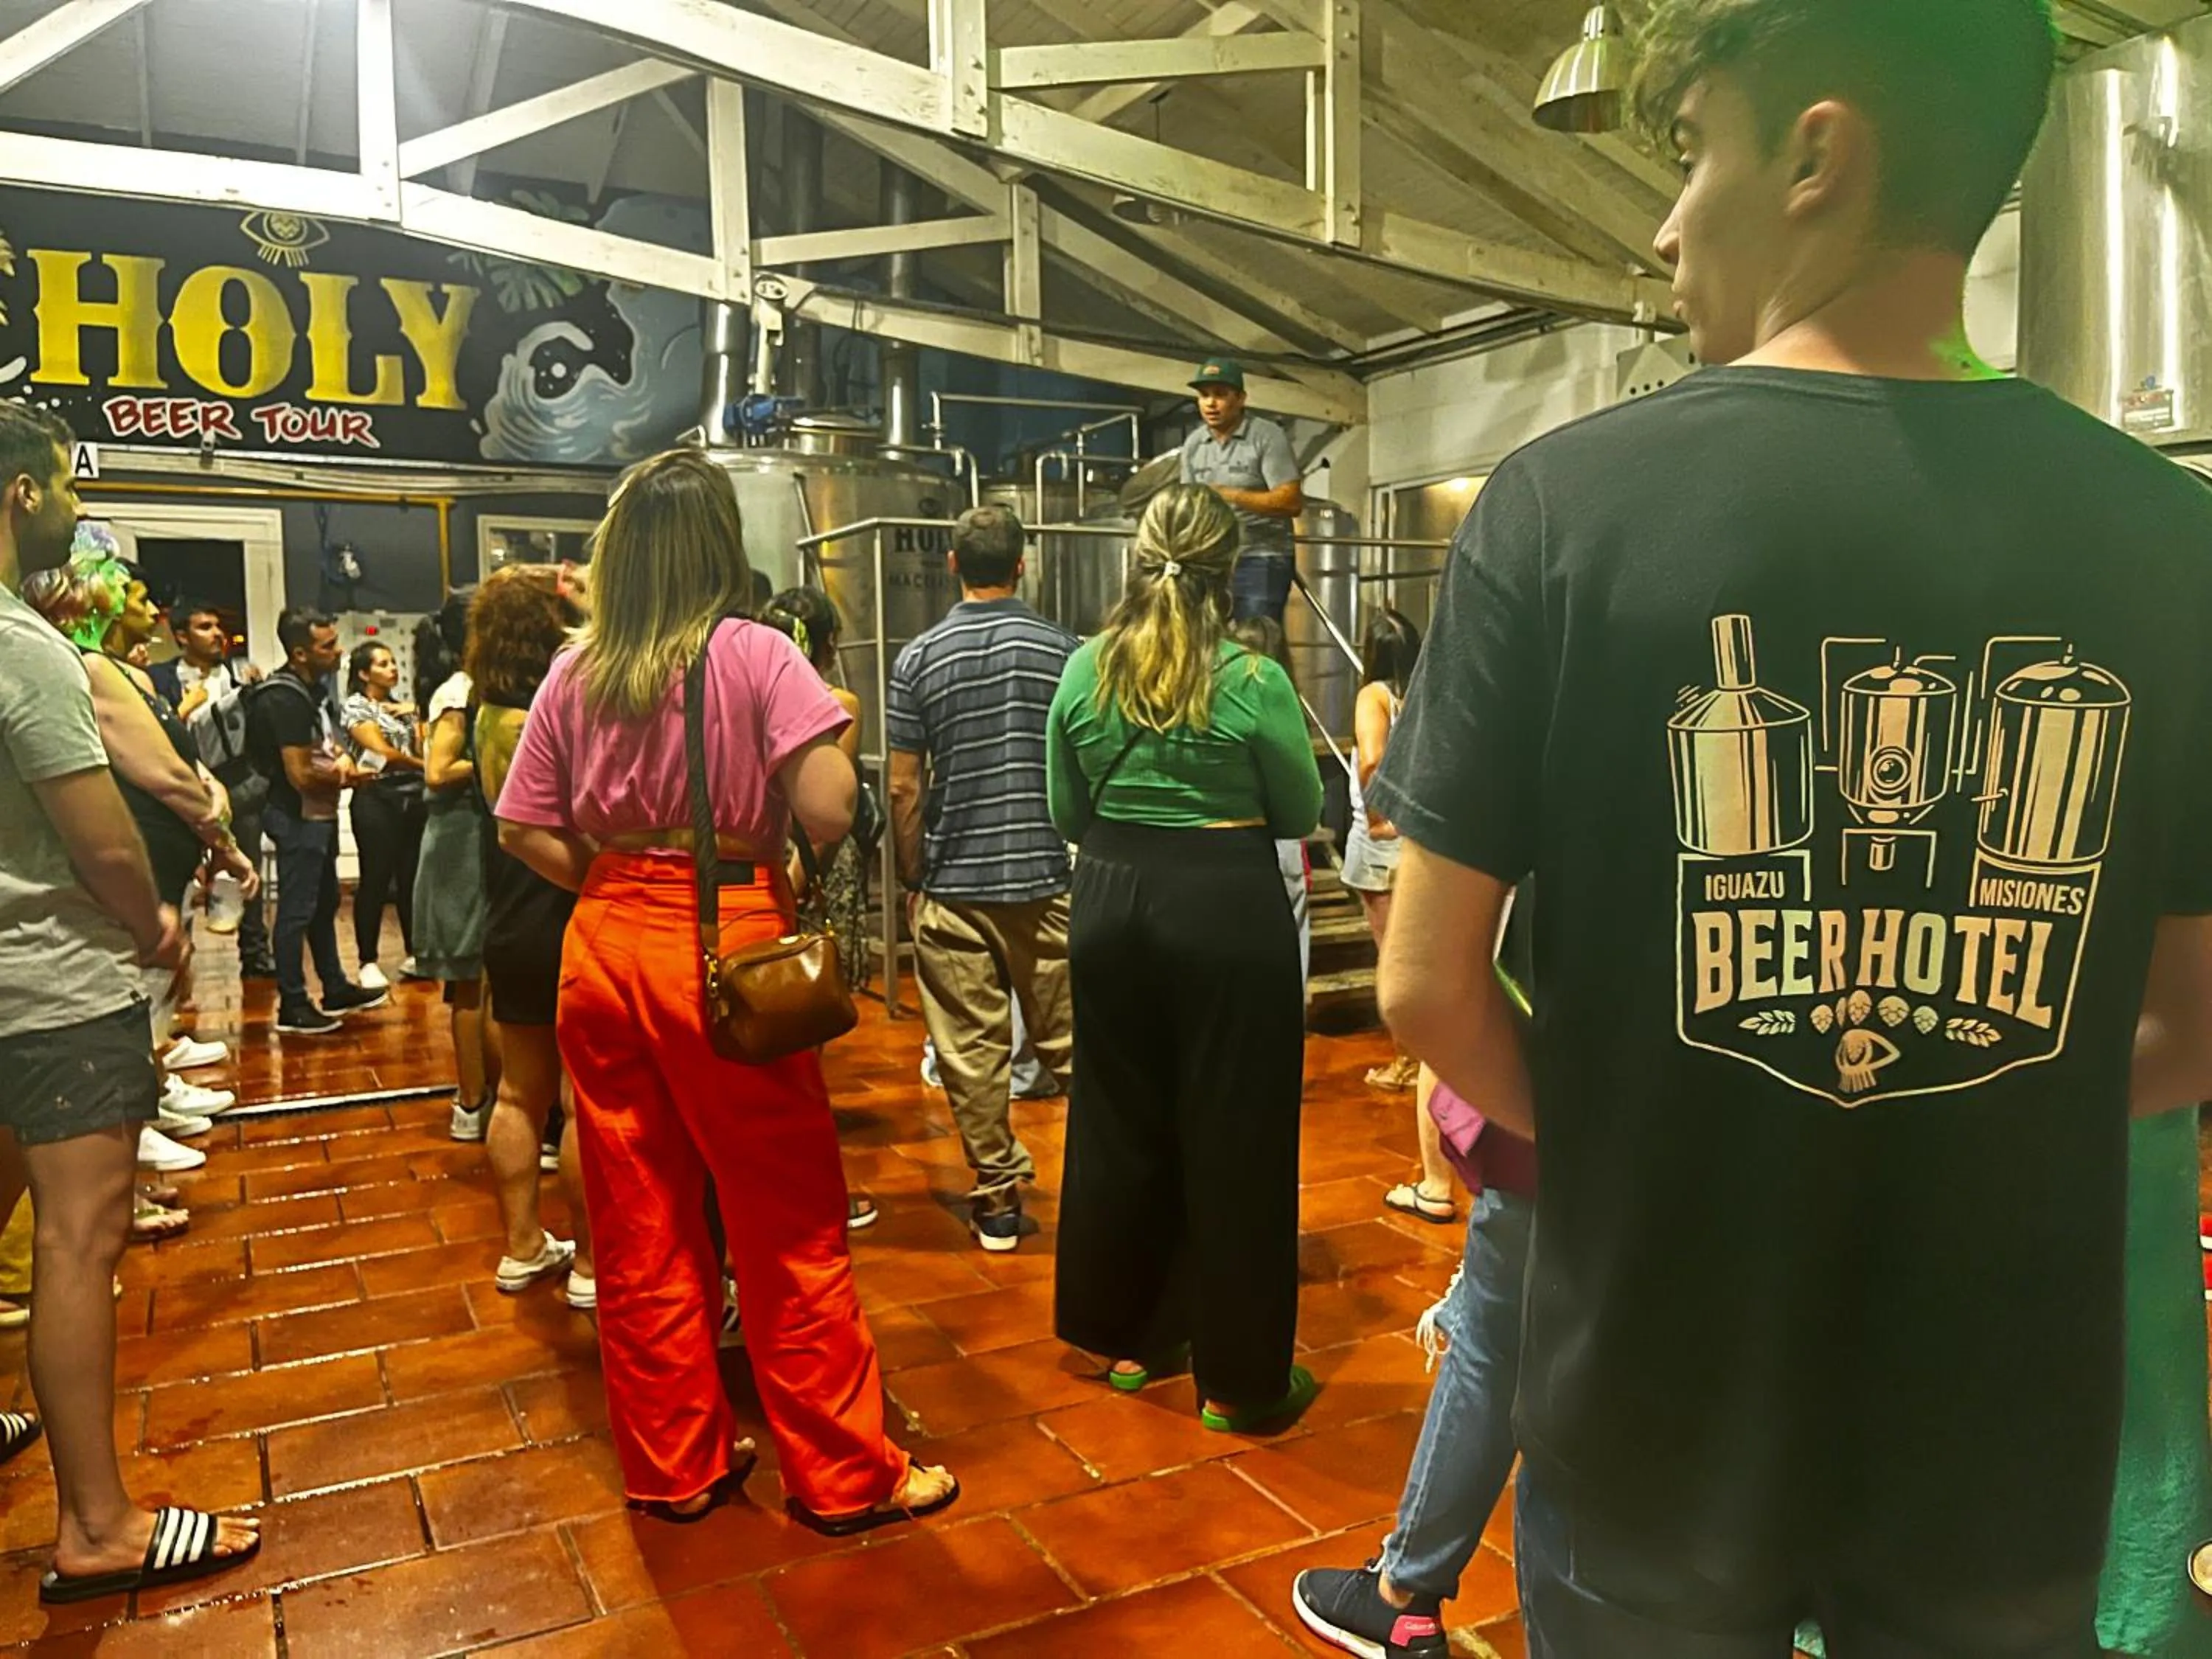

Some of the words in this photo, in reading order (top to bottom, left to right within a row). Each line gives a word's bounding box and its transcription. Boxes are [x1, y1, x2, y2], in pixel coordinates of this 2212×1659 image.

[27, 248, 481, 410] HOLY
[104, 395, 243, 441] BEER
[251, 403, 380, 448] TOUR
[1705, 870, 1785, 902] IGUAZU
[1979, 878, 2086, 915] MISIONES
[1691, 909, 1846, 1015] BEER
[1855, 908, 2053, 1029] HOTEL
